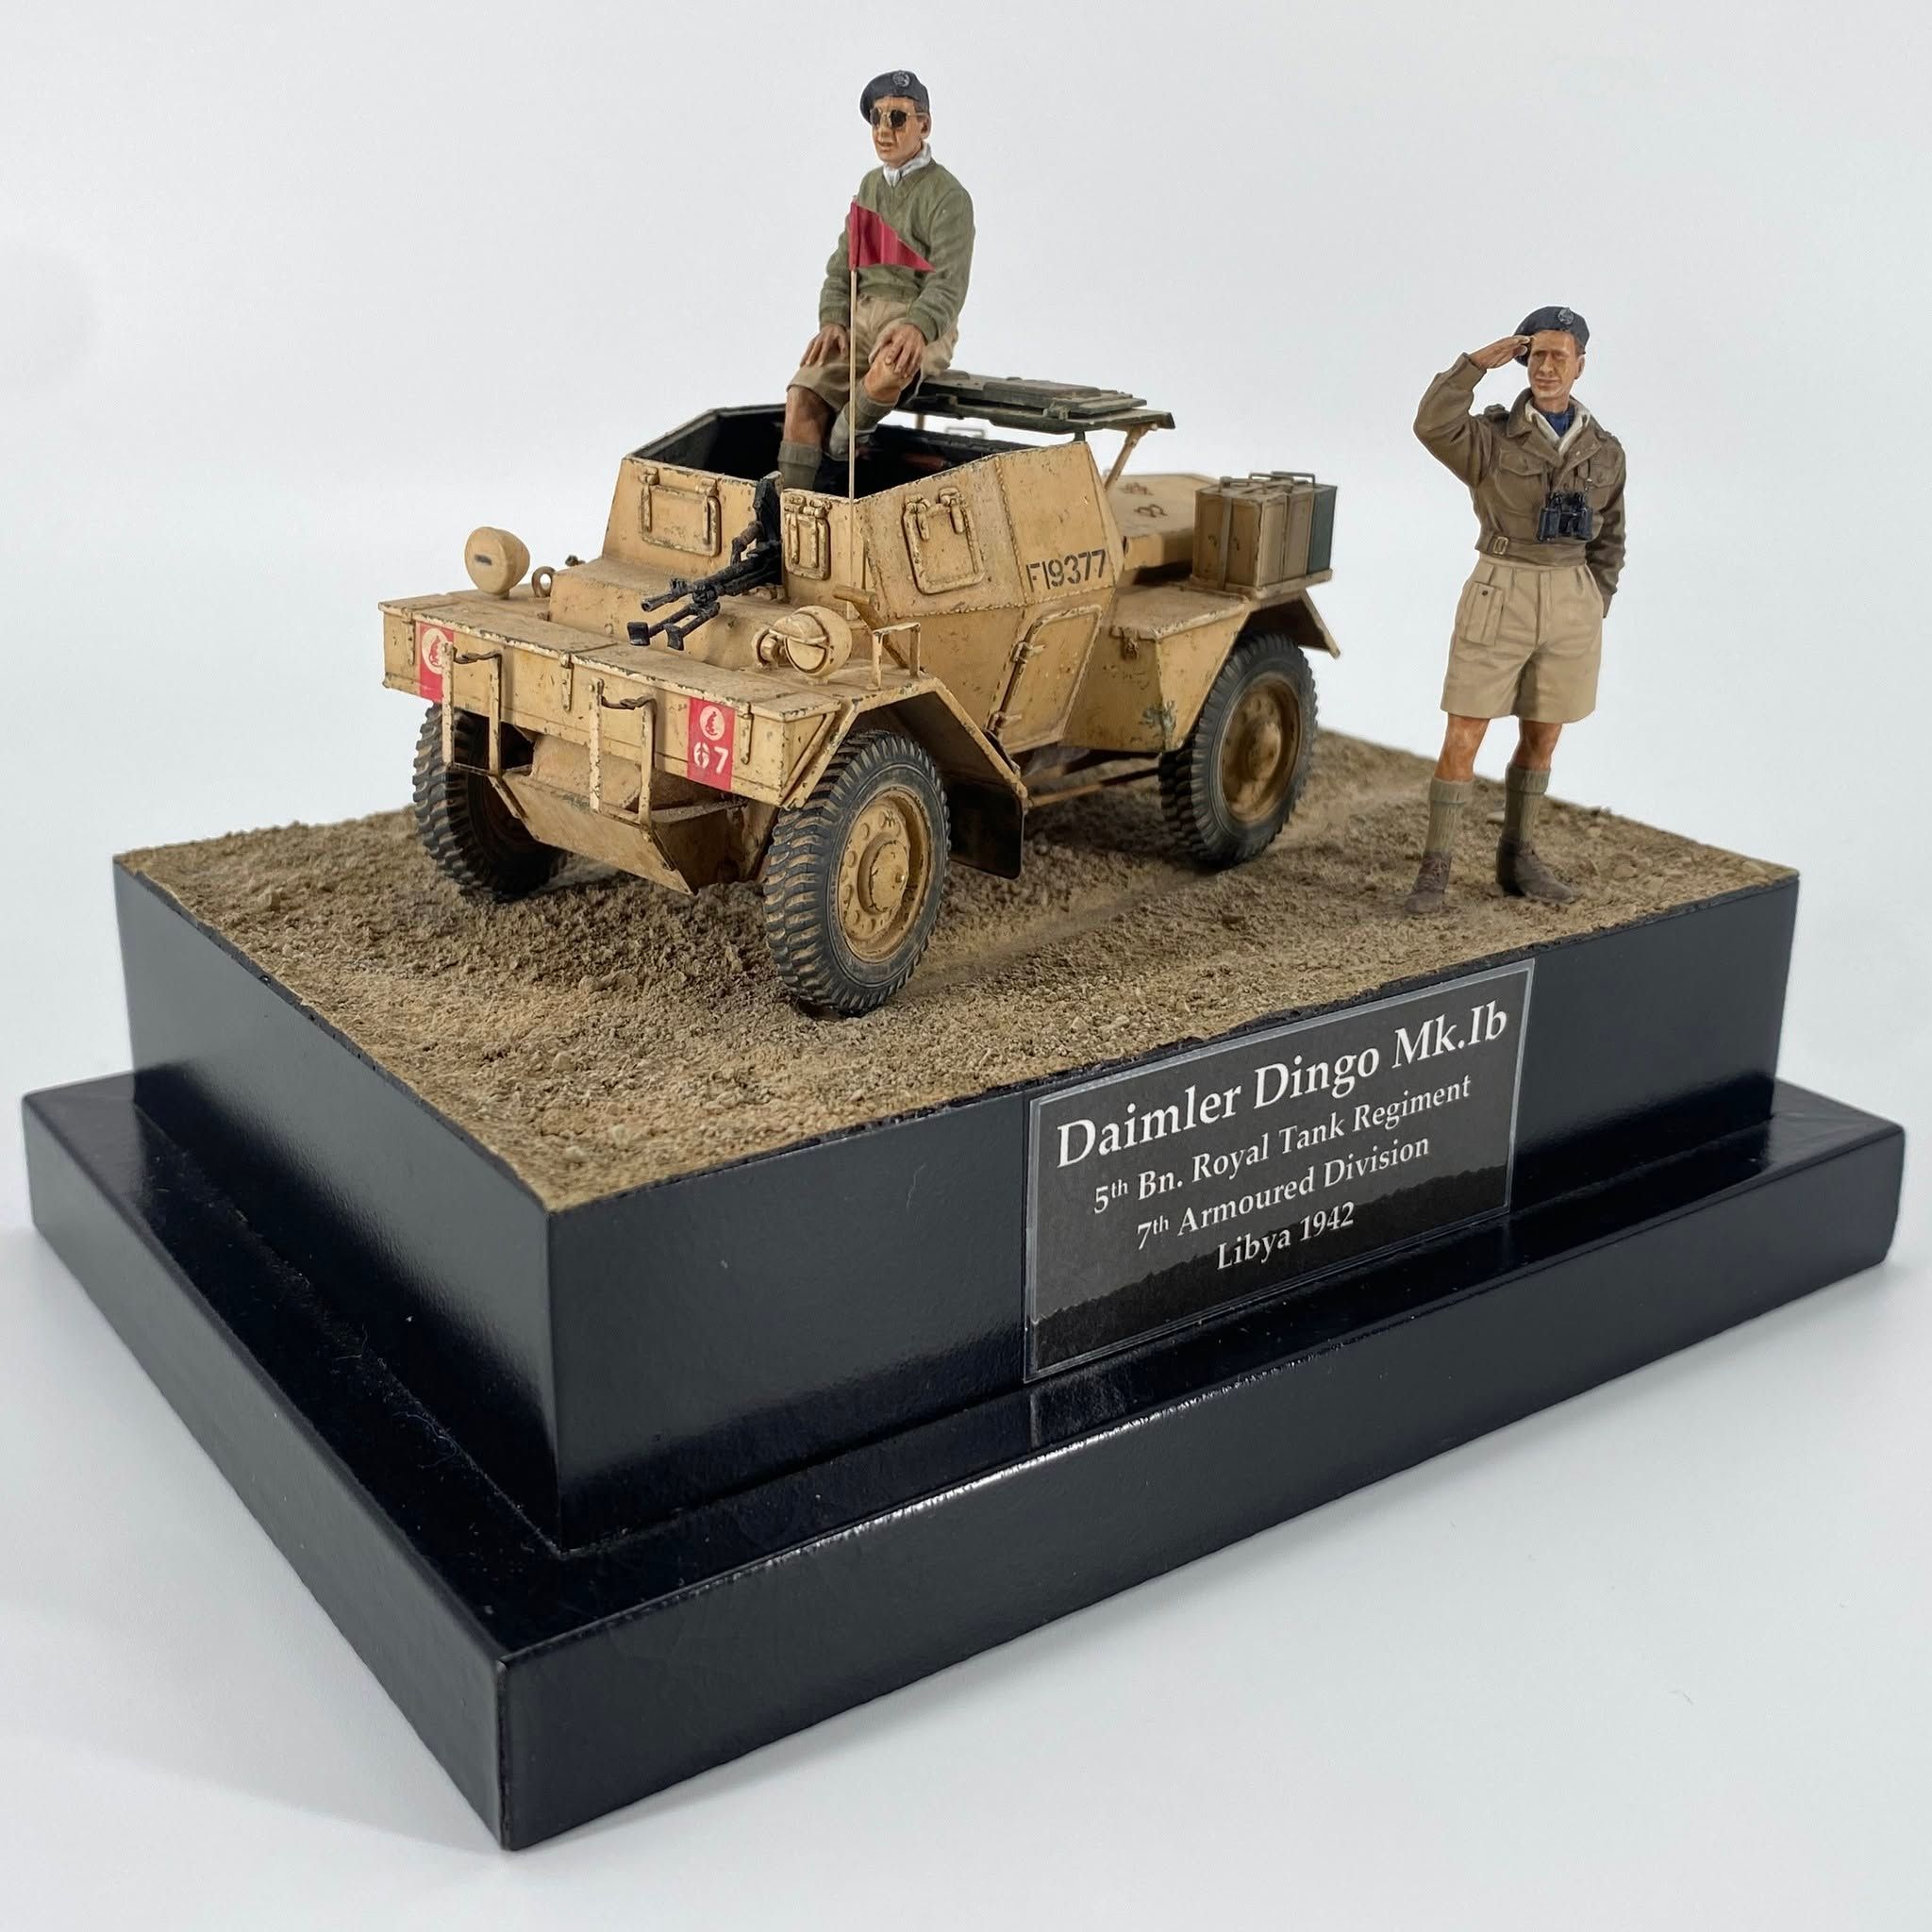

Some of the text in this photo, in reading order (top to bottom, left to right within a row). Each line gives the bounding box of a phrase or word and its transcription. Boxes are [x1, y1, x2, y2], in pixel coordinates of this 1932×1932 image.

[1025, 548, 1106, 592] F19377
[693, 741, 729, 774] 67
[1057, 1000, 1507, 1168] Daimler Dingo Mk.Ib
[1093, 1074, 1472, 1214] 5th Bn. Royal Tank Regiment
[1137, 1138, 1430, 1250] 7th Armoured Division
[1217, 1201, 1356, 1270] Libya 1942
